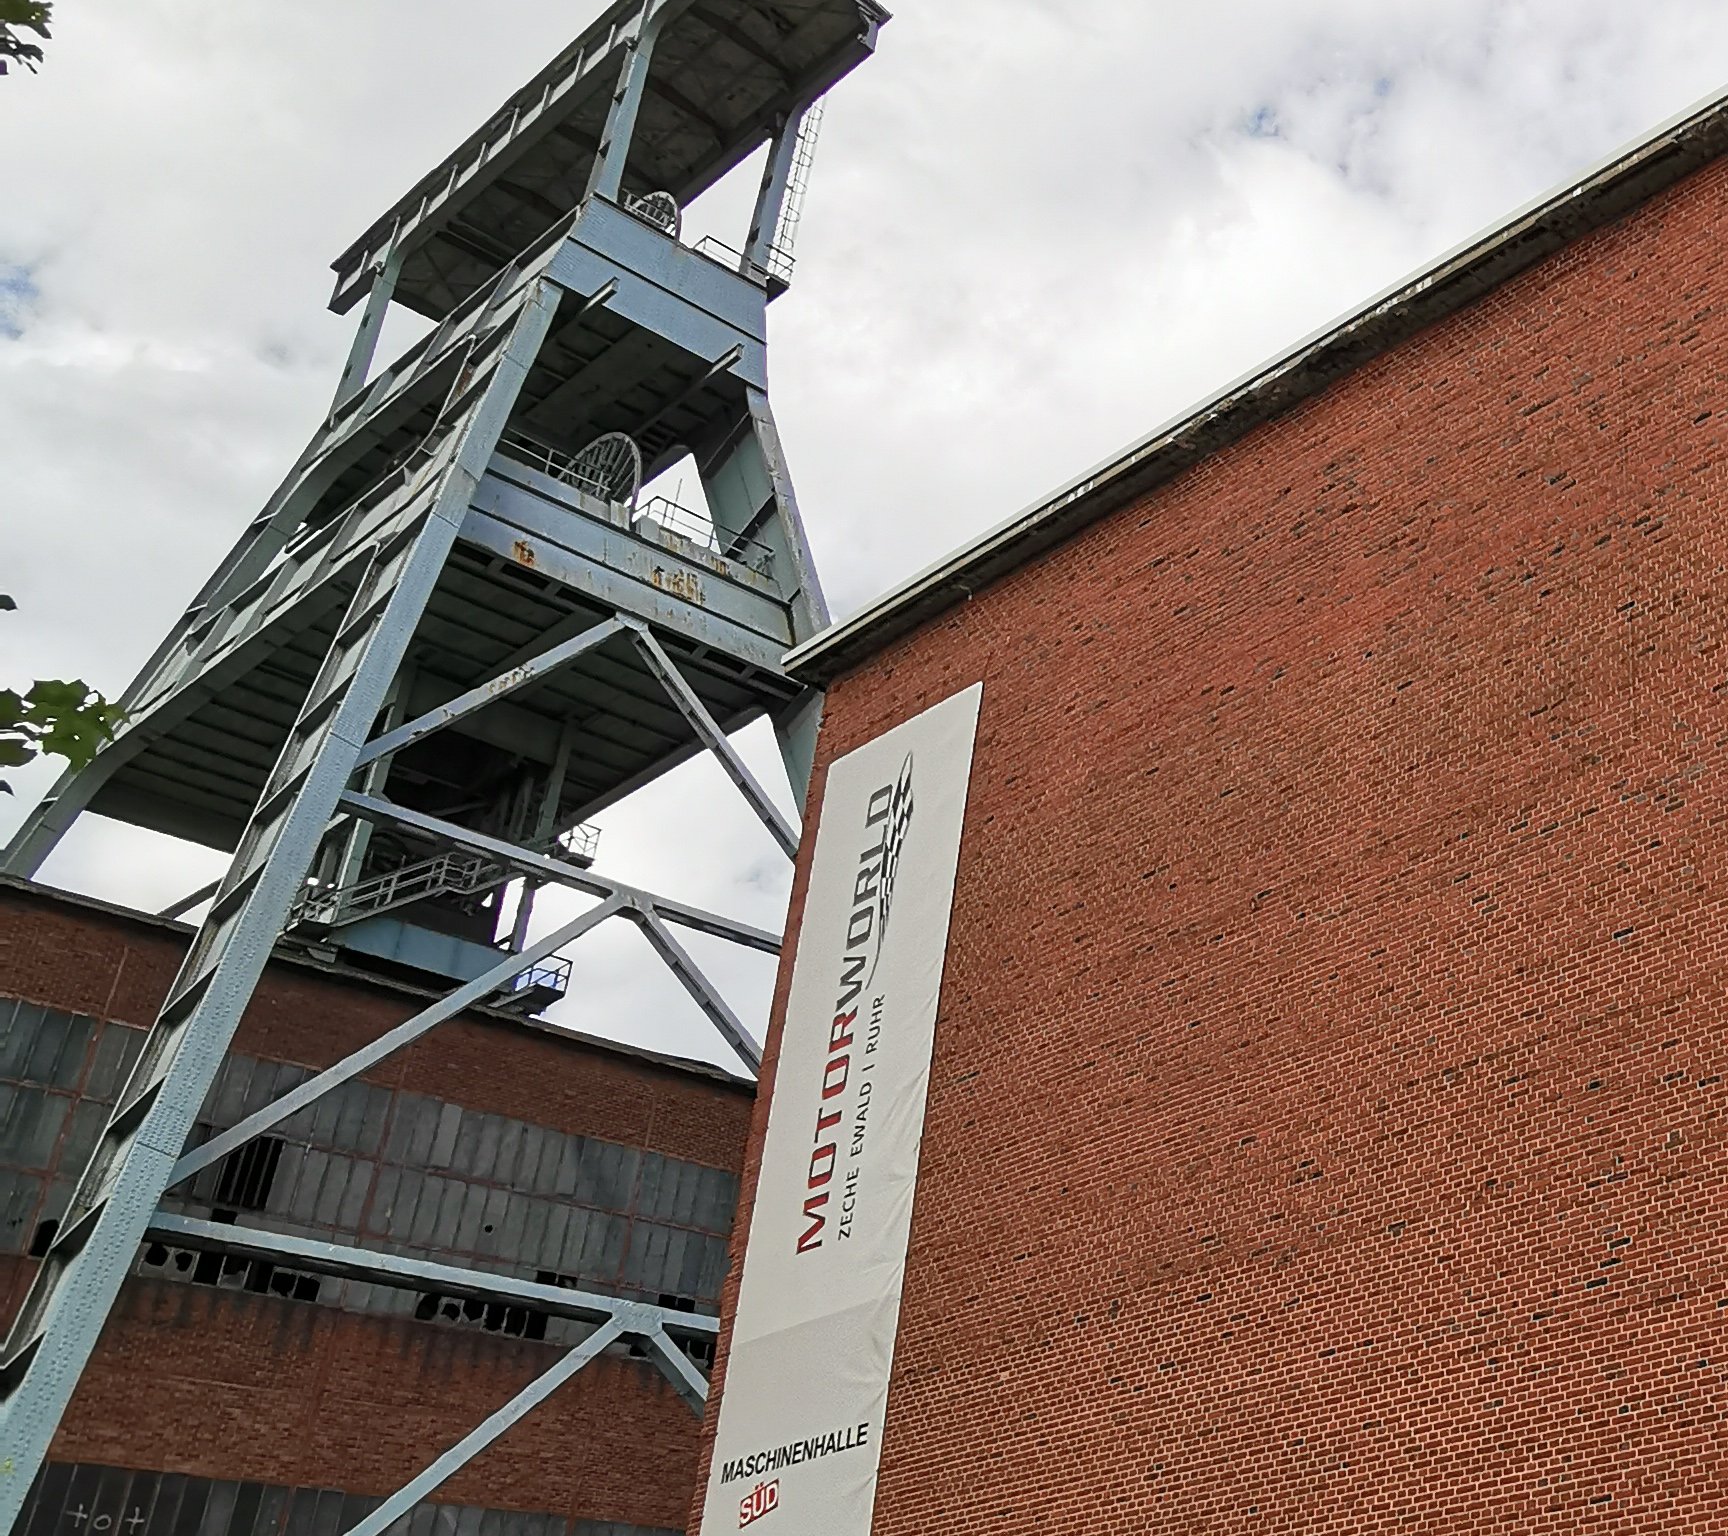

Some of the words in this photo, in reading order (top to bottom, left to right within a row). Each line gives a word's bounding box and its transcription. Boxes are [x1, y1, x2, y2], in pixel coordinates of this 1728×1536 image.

[796, 784, 893, 1255] MOTORWORLD
[838, 1167, 859, 1241] ZECHE
[850, 1081, 873, 1157] EWALD
[865, 994, 885, 1055] RUHR
[720, 1422, 869, 1484] MASCHINENHALLE
[740, 1481, 778, 1524] SÜD
